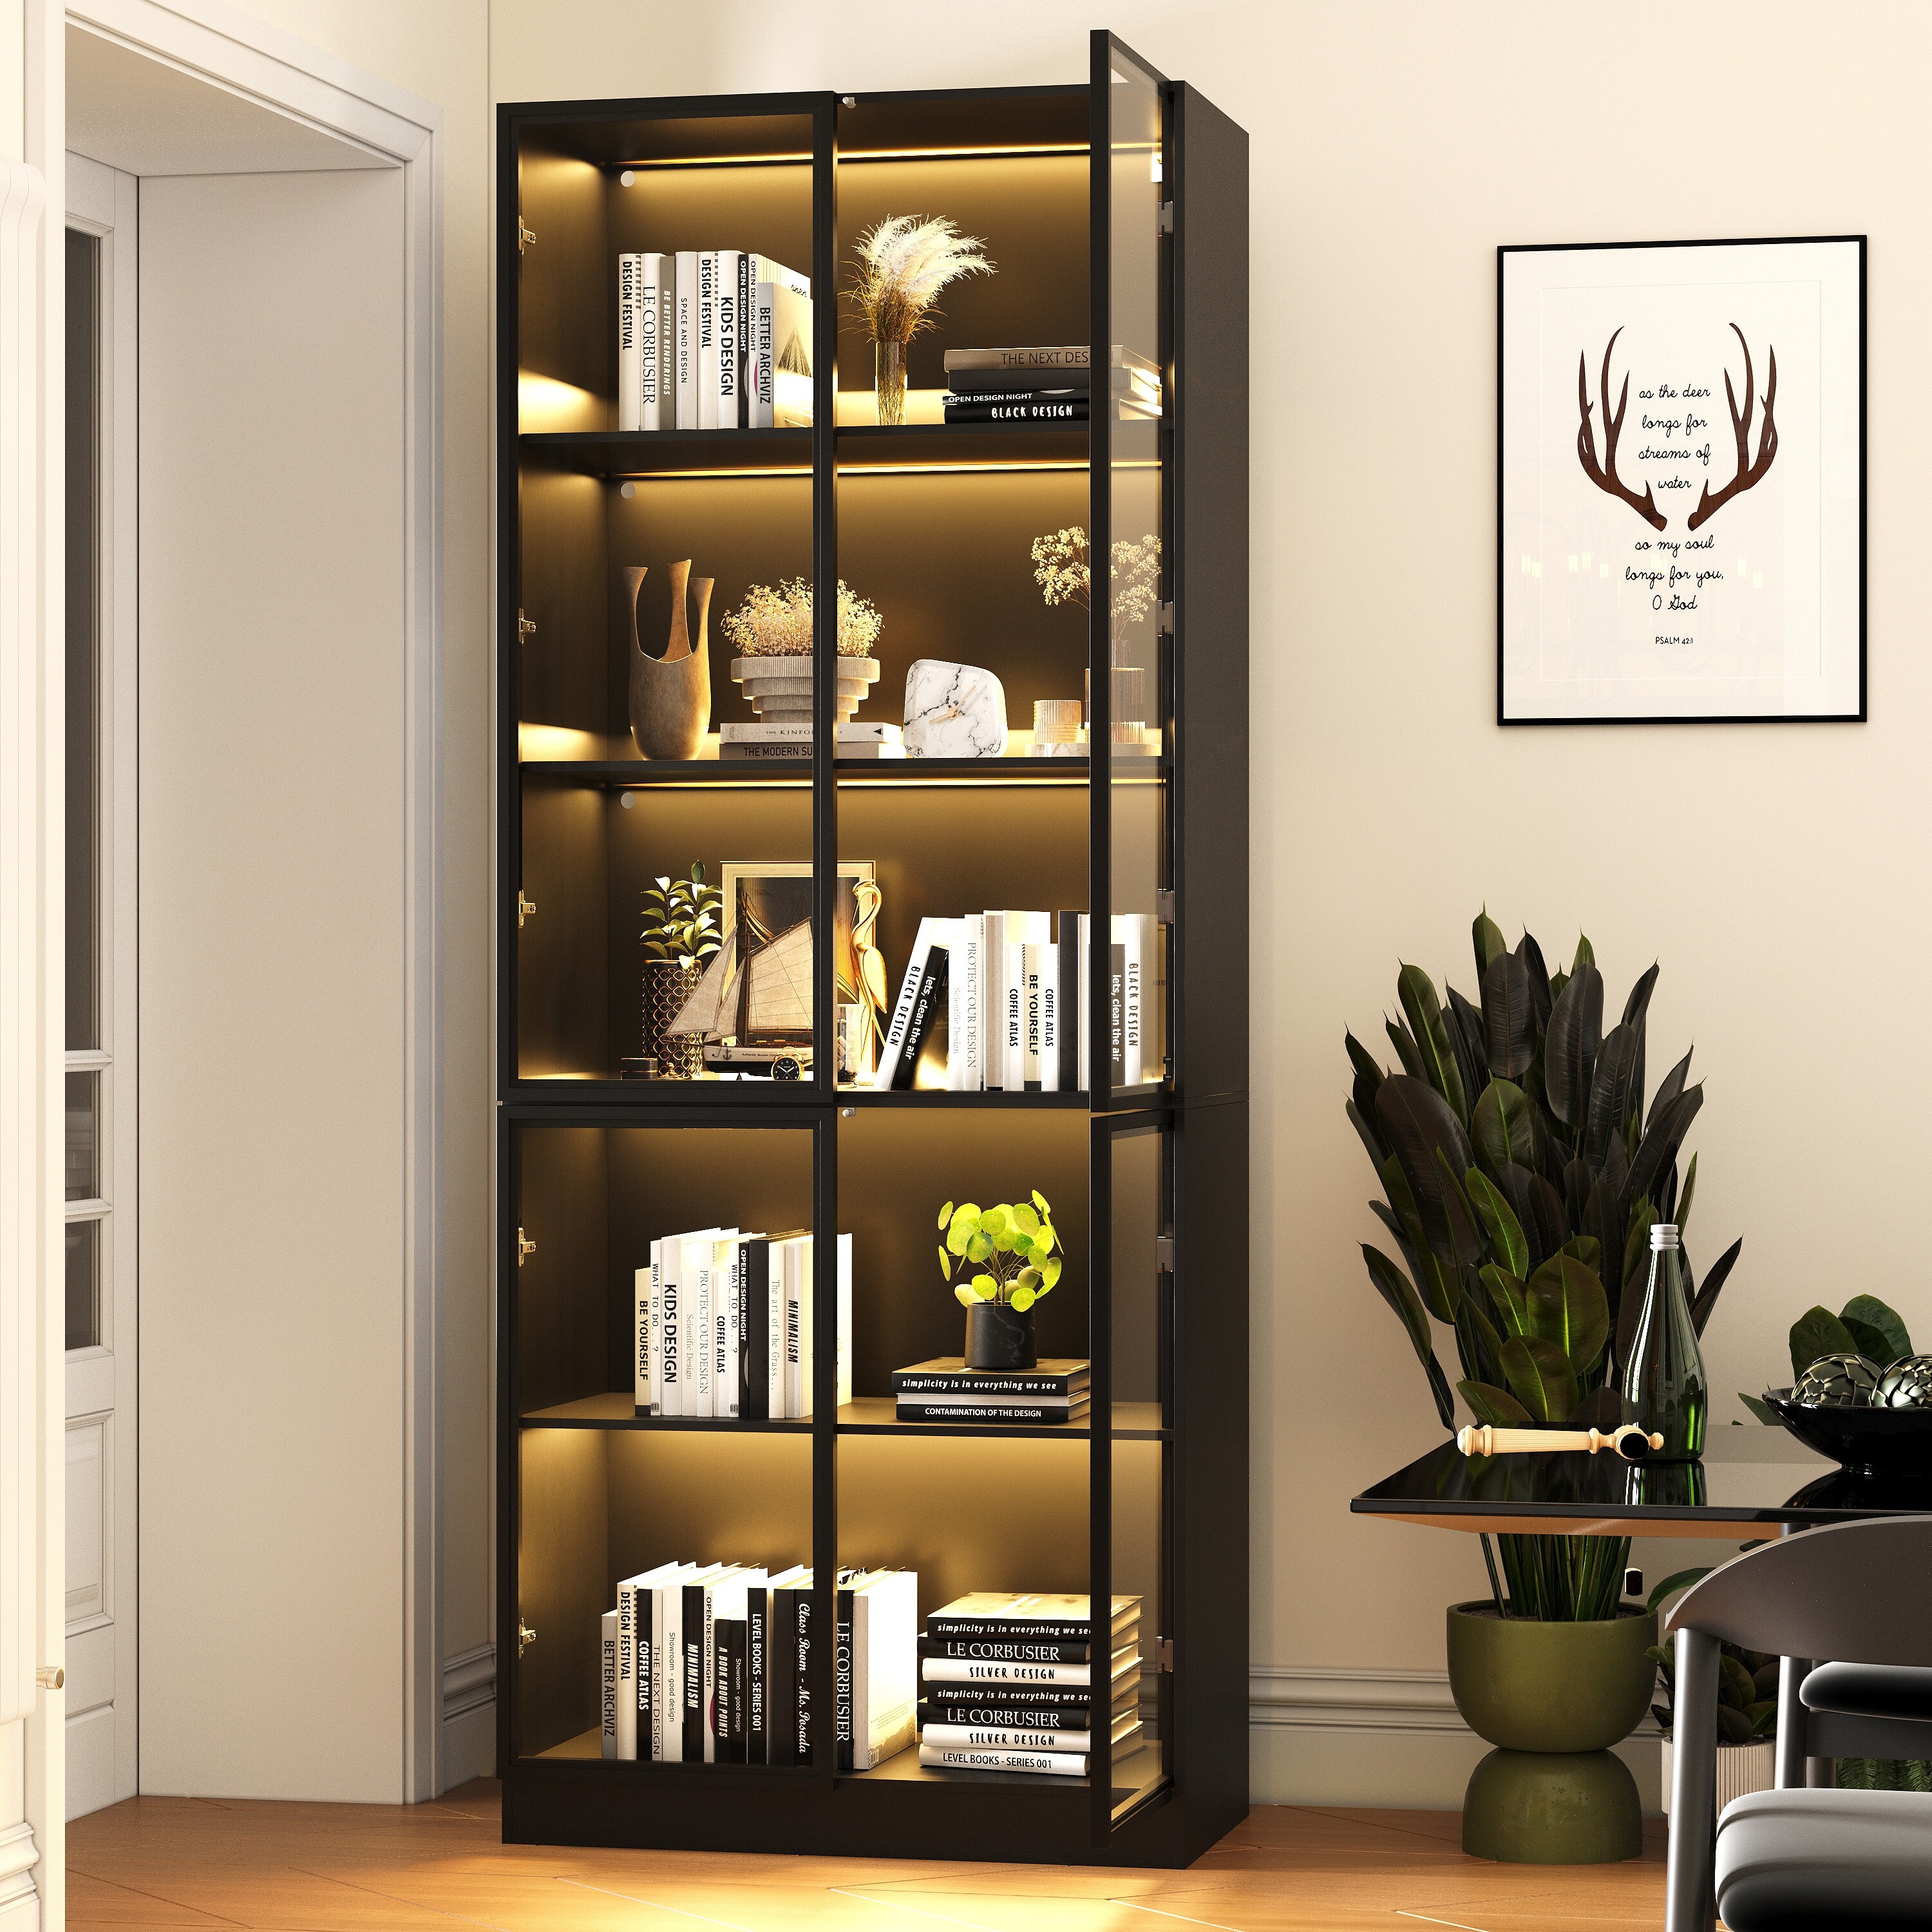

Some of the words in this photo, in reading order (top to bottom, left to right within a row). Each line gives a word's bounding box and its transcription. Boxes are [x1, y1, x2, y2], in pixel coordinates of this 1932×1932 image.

[623, 261, 632, 299] DESIGN
[702, 260, 711, 298] DESIGN
[643, 286, 655, 305] LE
[663, 290, 670, 301] BE
[623, 305, 632, 350] FESTIVAL
[702, 303, 711, 348] FESTIVAL
[721, 298, 733, 332] KIDS
[760, 308, 770, 349] BETTER
[643, 310, 655, 404] CORBUSIER
[721, 338, 733, 395] DESIGN
[1001, 354, 1024, 365] THE
[1029, 352, 1061, 364] NEXT
[1066, 352, 1088, 363] DES
[760, 353, 770, 403] ARCHVIZ
[1640, 390, 1654, 399] as
[1660, 384, 1678, 397] the
[1683, 384, 1710, 397] deer
[992, 406, 1026, 418] BLACK
[1033, 406, 1072, 417] DESIGN
[1642, 415, 1681, 438] longs
[1686, 413, 1707, 435] for
[1638, 446, 1690, 459] streams
[1696, 444, 1710, 466] of
[1658, 476, 1691, 488] water
[1657, 542, 1680, 558] my
[1685, 535, 1714, 549] soul
[1626, 567, 1664, 589] longs
[1669, 565, 1690, 587] for
[1696, 571, 1723, 588] you,
[1653, 595, 1662, 610] O
[1668, 594, 1698, 610] God
[744, 748, 759, 756] THE
[763, 747, 798, 756] MODERN
[967, 943, 976, 994] PROTECT
[1129, 963, 1139, 998] BLACK
[904, 967, 920, 1000] BLACK
[921, 976, 936, 996] lets,
[1030, 975, 1037, 989] BE
[1111, 974, 1121, 996] lets,
[914, 999, 928, 1025] clean
[967, 997, 976, 1023] OUR
[1112, 999, 1121, 1025] clean
[889, 1007, 909, 1045] DESIGN
[909, 1027, 921, 1043] the
[1112, 1028, 1121, 1045] the
[1128, 1006, 1138, 1046] DESIGN
[905, 1045, 914, 1059] air
[967, 1026, 976, 1068] DESIGN
[1112, 1048, 1121, 1061] air
[640, 1301, 648, 1314] BE
[665, 1285, 676, 1320] KIDS
[772, 1319, 779, 1329] of
[788, 1300, 798, 1363] MINIMALISM
[639, 1320, 648, 1380] YOURSELF
[665, 1325, 676, 1382] DESIGN
[902, 1379, 948, 1389] simplicity
[974, 1381, 1023, 1390] everything
[621, 1592, 630, 1630] DESIGN
[799, 1604, 810, 1633] Class
[753, 1614, 761, 1641] LEVEL
[837, 1622, 849, 1642] LE
[938, 1624, 983, 1634] simplicity
[1010, 1626, 1059, 1635] everything
[605, 1641, 614, 1684] BETTER
[621, 1635, 630, 1680] FESTIVAL
[639, 1642, 649, 1676] COFFEE
[753, 1643, 761, 1674] BOOKS
[799, 1638, 810, 1671] Room
[947, 1642, 965, 1656] LE
[969, 1643, 1060, 1661] CORBUSIER
[688, 1643, 698, 1708] MINIMALISM
[719, 1656, 727, 1677] BOOK
[970, 1667, 1007, 1678] SILVER
[1015, 1669, 1054, 1679] DESIGN
[639, 1680, 649, 1710] ATLAS
[753, 1683, 761, 1712] SERIES
[799, 1686, 810, 1707] Ms.
[837, 1647, 849, 1741] CORBUSIER
[605, 1685, 614, 1736] ARCHVIZ
[753, 1715, 761, 1730] 001
[799, 1711, 810, 1753] Posada
[943, 1753, 968, 1763] LEVEL
[971, 1755, 999, 1765] BOOKS
[1007, 1757, 1034, 1767] SERIES
[1037, 1759, 1051, 1768] 001
